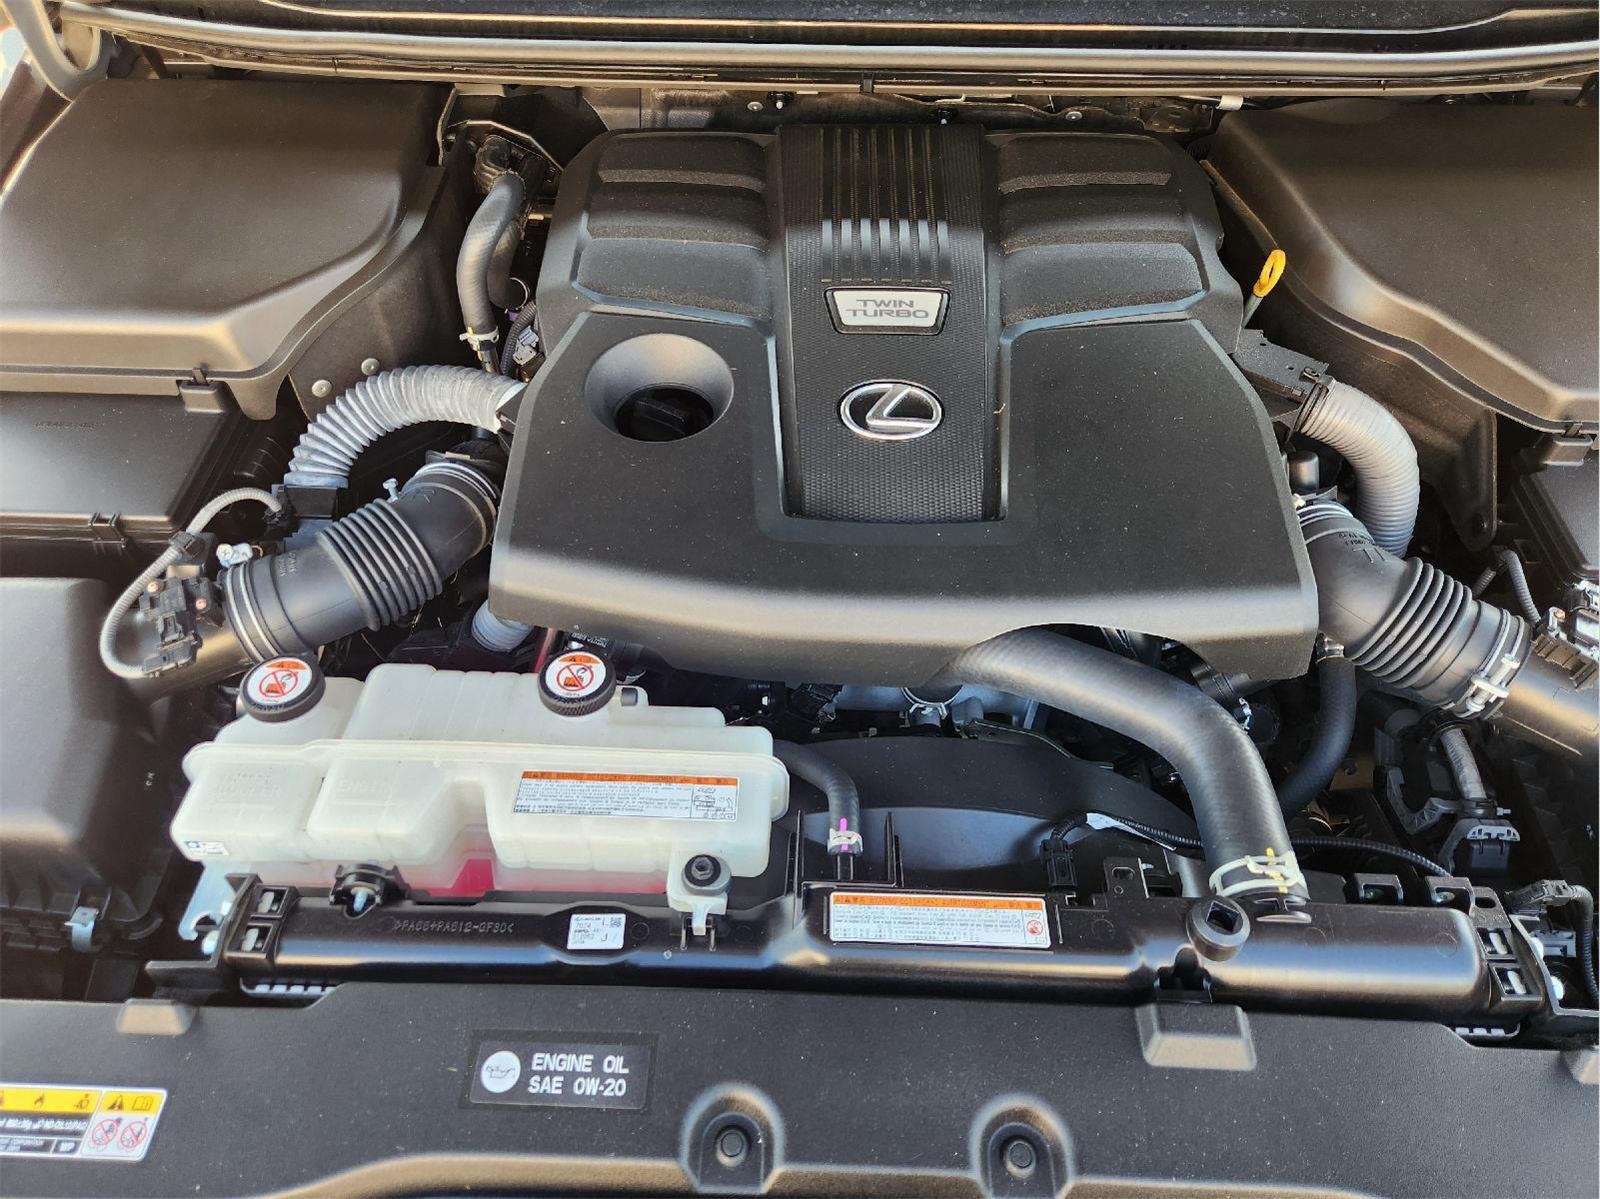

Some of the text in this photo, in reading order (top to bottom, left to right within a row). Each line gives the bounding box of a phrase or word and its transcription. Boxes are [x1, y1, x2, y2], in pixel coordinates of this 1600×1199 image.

[856, 299, 914, 308] TWIN
[845, 309, 929, 319] TURBO
[531, 1052, 630, 1075] ENGINE OIL
[527, 1075, 627, 1097] SAE 0W-20
